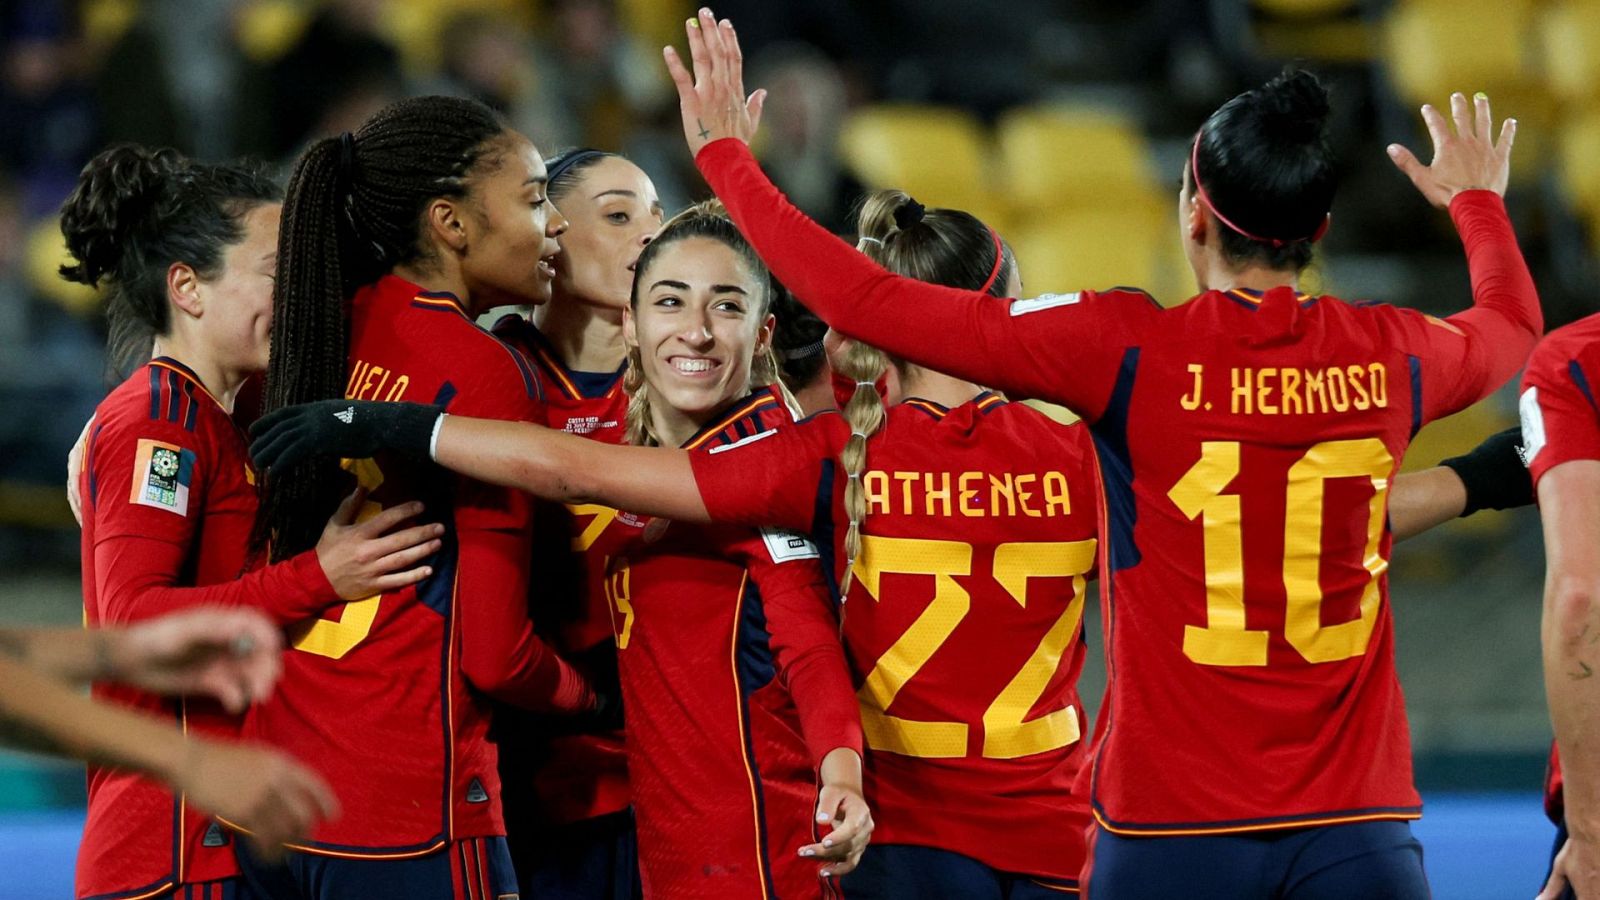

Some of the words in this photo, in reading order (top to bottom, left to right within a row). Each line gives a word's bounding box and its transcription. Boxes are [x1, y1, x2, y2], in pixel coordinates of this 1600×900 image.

[1180, 364, 1213, 411] J.
[1231, 363, 1388, 415] HERMOSO
[864, 470, 1071, 518] ATHENEA
[1167, 438, 1394, 667] 10
[852, 534, 1098, 759] 22
